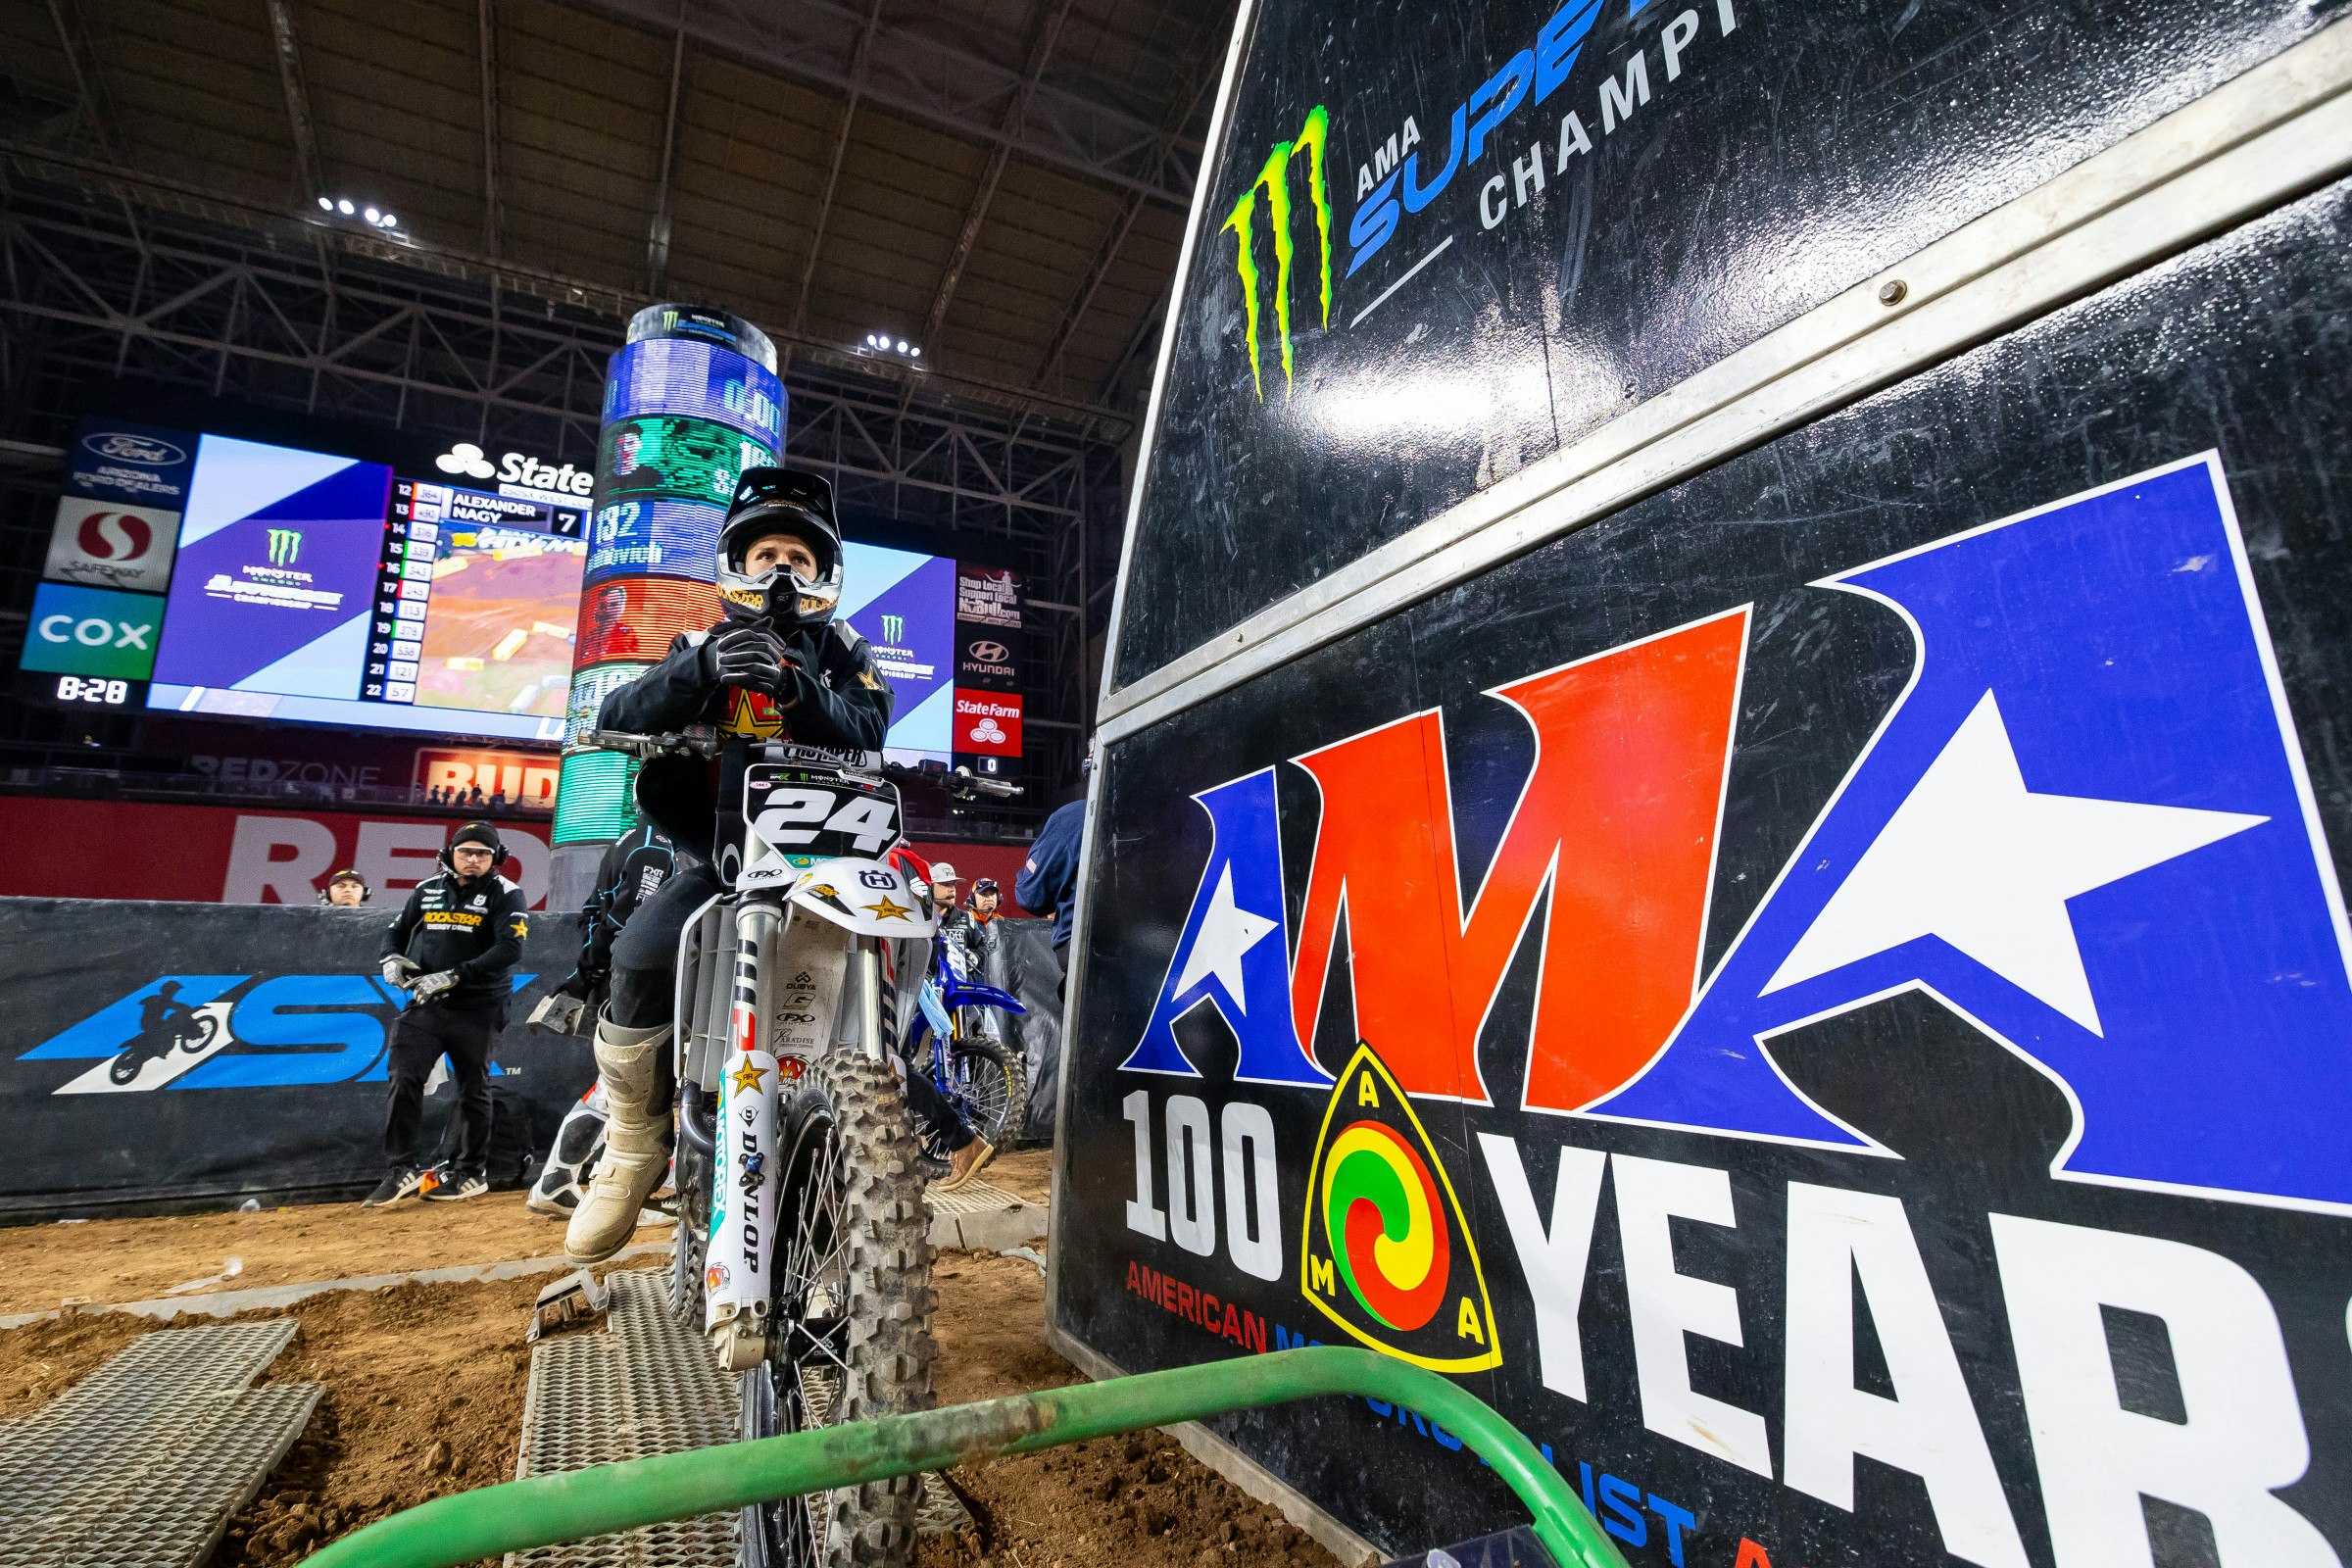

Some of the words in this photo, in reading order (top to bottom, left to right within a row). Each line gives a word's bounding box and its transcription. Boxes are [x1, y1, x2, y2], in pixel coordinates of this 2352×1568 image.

[1346, 0, 1652, 279] SUPE
[1357, 115, 1421, 203] AMA
[496, 452, 594, 496] State
[453, 494, 537, 517] ALEXANDER
[558, 514, 577, 533] 7
[453, 507, 502, 524] NAGY
[392, 522, 407, 535] 14
[389, 542, 404, 555] 15
[385, 562, 401, 574] 16
[383, 581, 398, 594] 17
[959, 576, 981, 590] Shop
[983, 580, 1005, 593] Local
[959, 586, 994, 601] Support
[995, 592, 1017, 605] Local
[379, 601, 395, 613] 18
[38, 613, 152, 651] COX
[376, 621, 392, 634] 19
[372, 642, 389, 655] 20
[369, 662, 385, 675] 21
[962, 662, 1015, 676] HYUNDAI
[57, 676, 128, 705] 8:28
[366, 684, 382, 697] 22
[391, 688, 409, 698] 57
[754, 788, 897, 854] 24
[1118, 448, 2352, 1214] AMA
[643, 865, 664, 878] FXR
[423, 911, 483, 927] ROCKSTAR
[786, 982, 817, 991] DUBYA
[506, 1066, 521, 1076] TM
[1358, 1070, 1380, 1108] A
[713, 1106, 727, 1221] MOTOREX
[1122, 1088, 1283, 1283] 100
[742, 1130, 760, 1274] DNLOP
[1126, 1260, 1267, 1354] AMERICAN
[1310, 1253, 1336, 1297] M
[1457, 1296, 1485, 1345] A
[1476, 1132, 2352, 1568] YEAR
